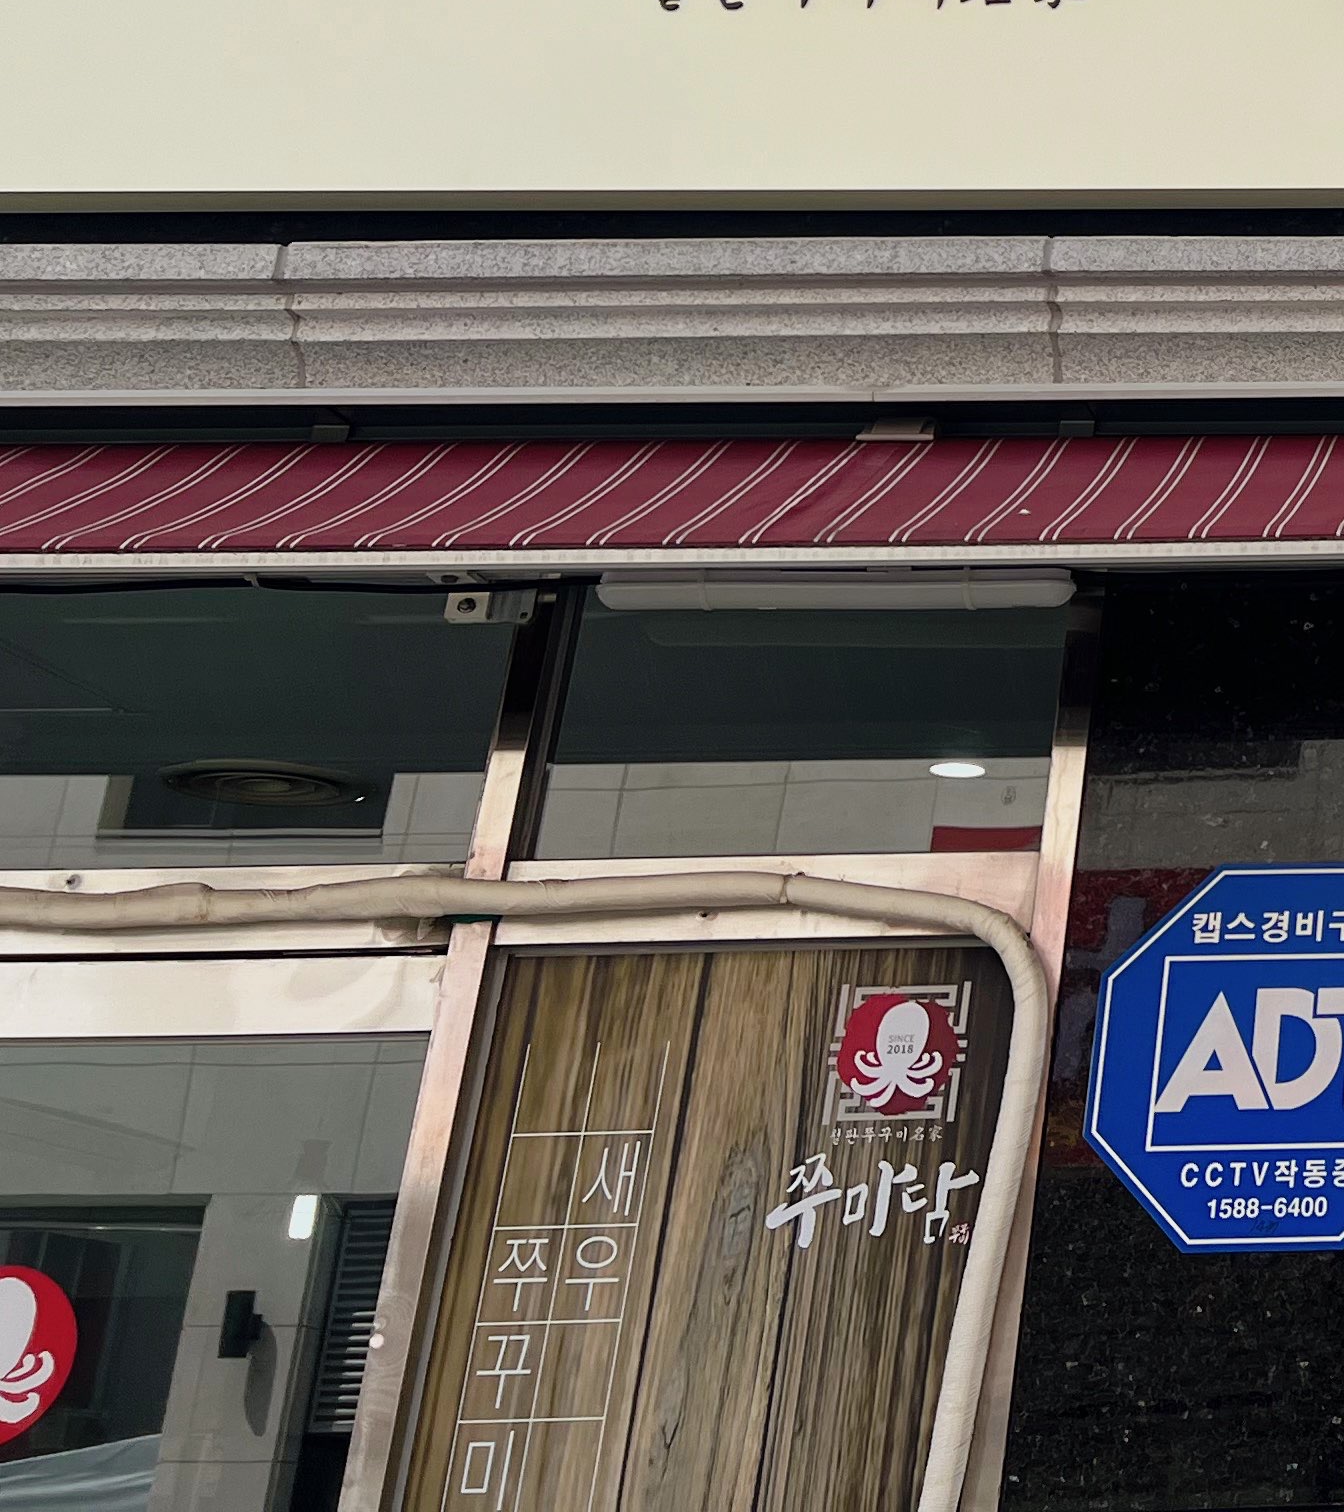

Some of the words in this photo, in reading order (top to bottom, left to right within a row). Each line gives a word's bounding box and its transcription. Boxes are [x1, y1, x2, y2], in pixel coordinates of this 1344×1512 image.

[888, 1034, 915, 1043] SINCE
[886, 1044, 914, 1055] 2018
[1206, 1195, 1329, 1220] 1588-6400
